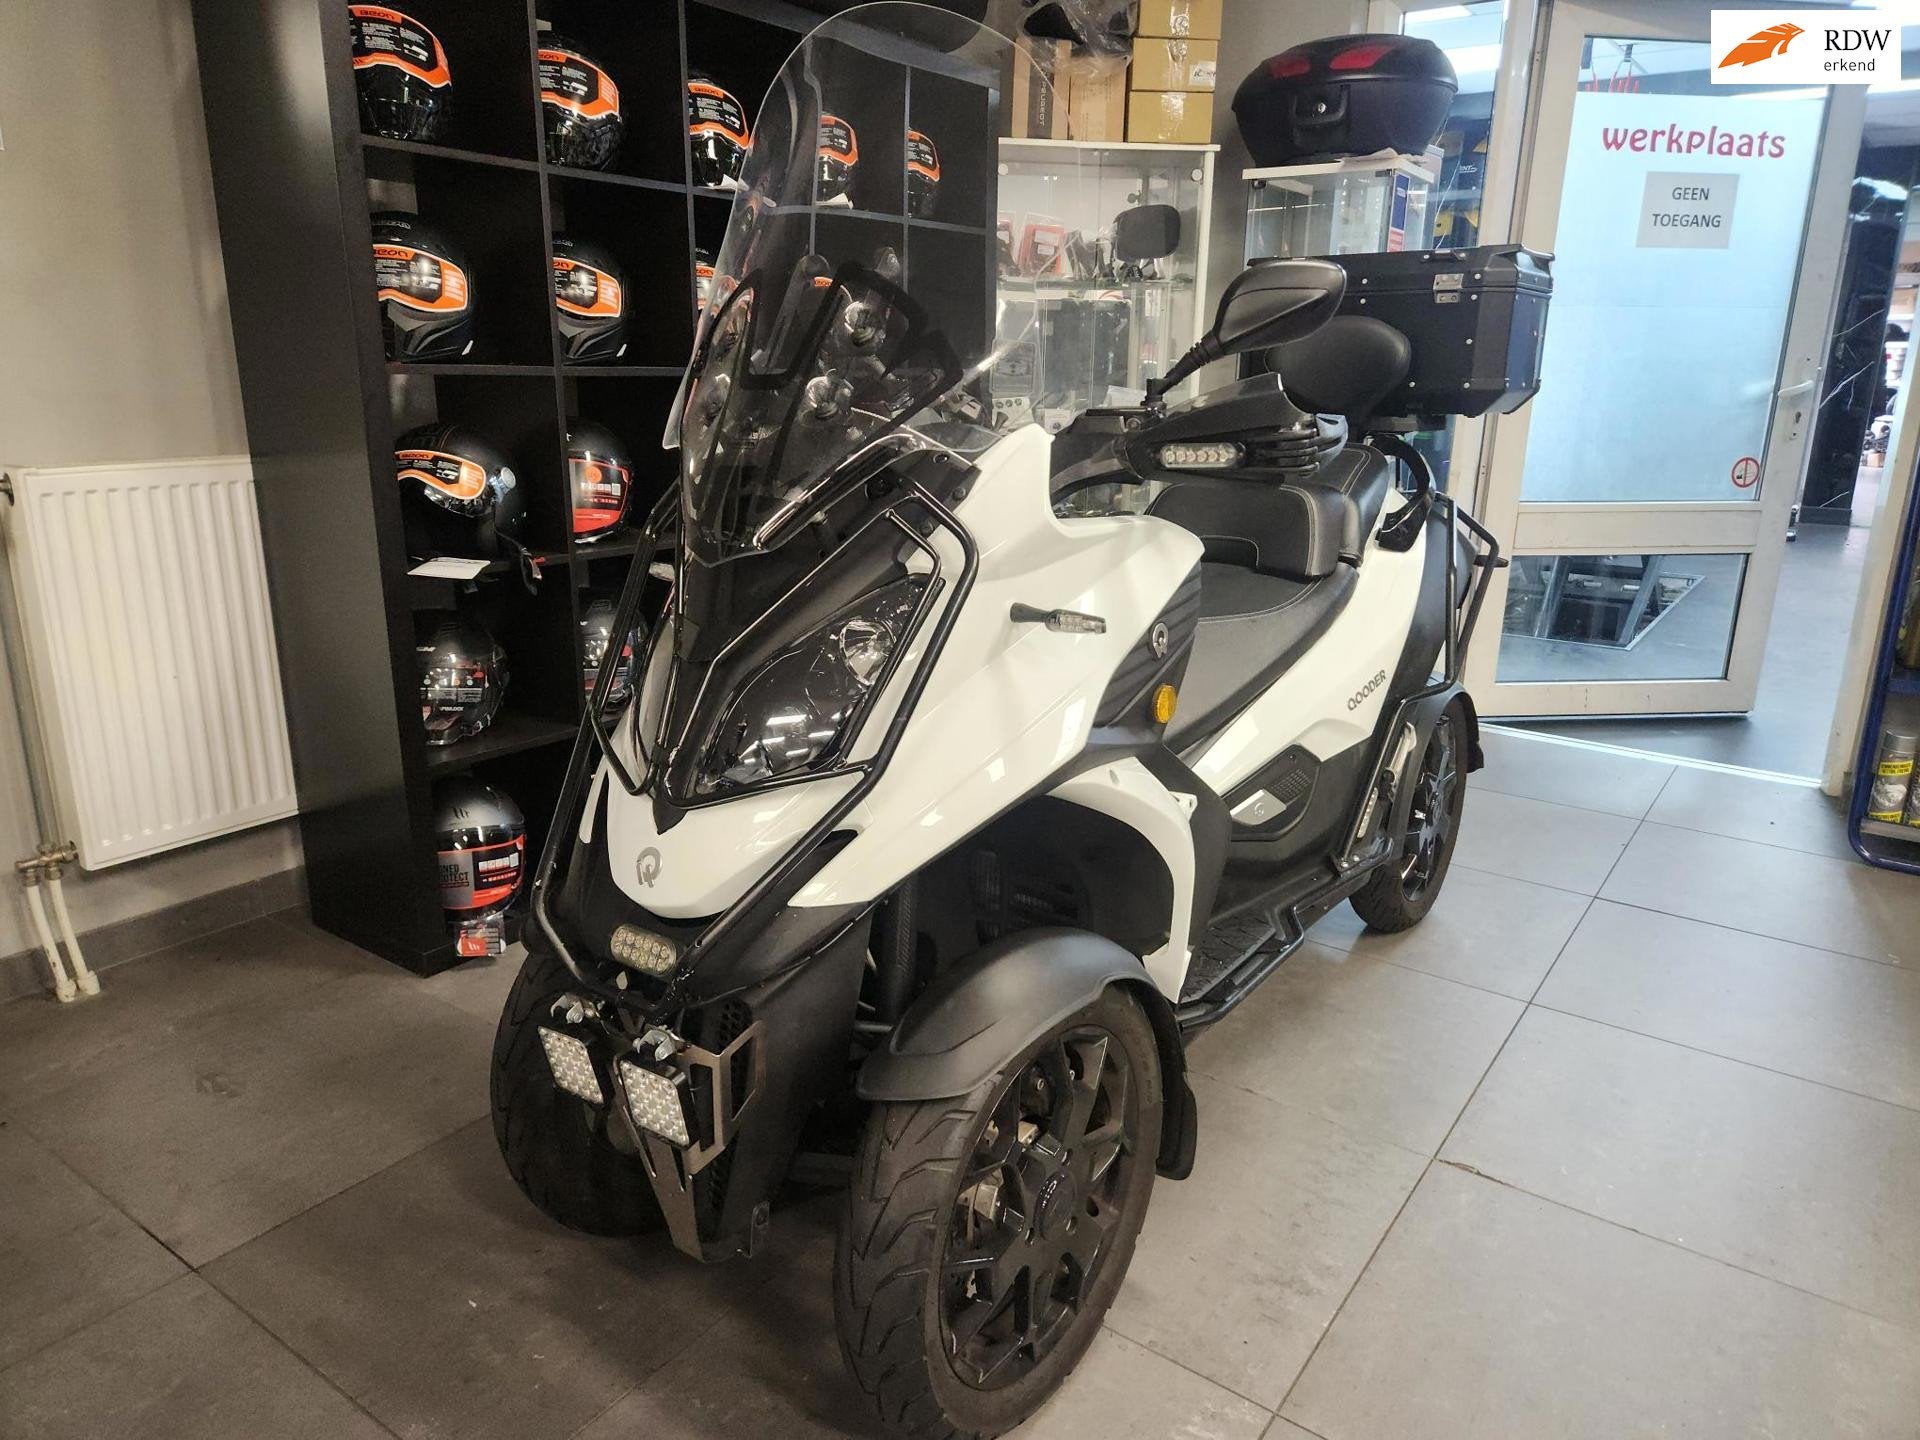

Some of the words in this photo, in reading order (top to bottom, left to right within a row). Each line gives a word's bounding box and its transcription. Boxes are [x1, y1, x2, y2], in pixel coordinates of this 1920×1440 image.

[1602, 123, 1786, 158] werkplaats
[1671, 187, 1710, 201] GEEN
[1652, 213, 1722, 228] TOEGANG
[1347, 669, 1386, 711] QOODER
